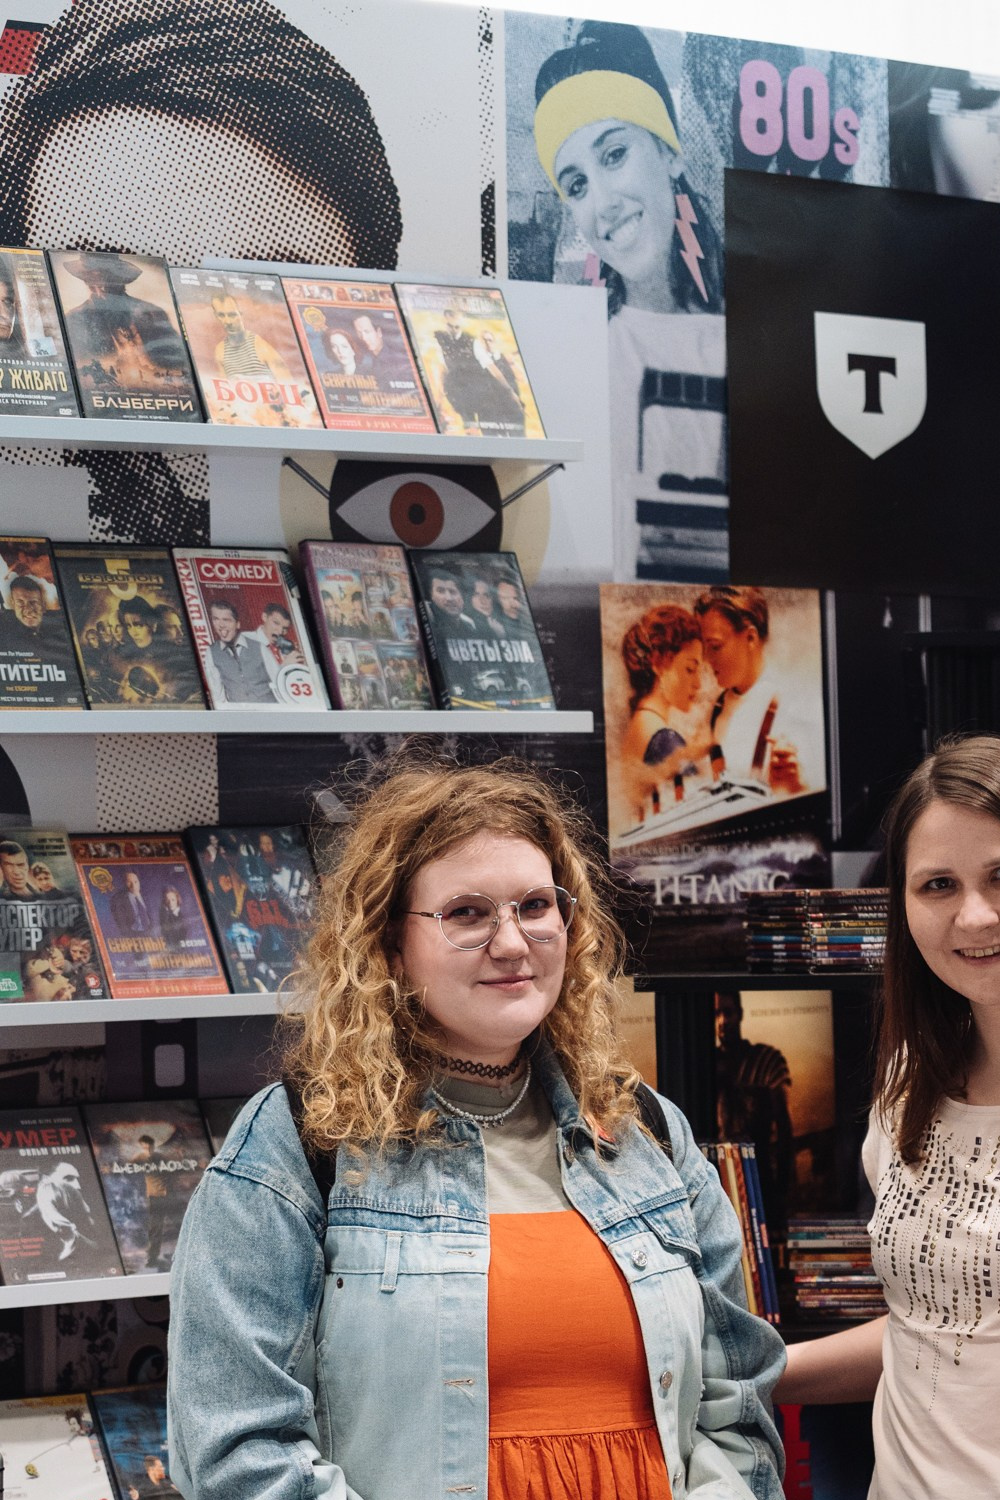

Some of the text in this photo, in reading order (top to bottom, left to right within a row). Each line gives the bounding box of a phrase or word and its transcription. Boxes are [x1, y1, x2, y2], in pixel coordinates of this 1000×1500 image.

[739, 59, 860, 166] 80s
[8, 367, 68, 392] ЖИВАГО
[846, 352, 897, 415] T
[91, 396, 194, 412] БЛУБЕРРИ
[211, 378, 306, 408] БОЕЦ
[201, 562, 274, 580] COMEDY
[175, 557, 206, 621] ШУТКИ
[447, 639, 536, 665] ЦВЕТЫ ЗЛА
[0, 664, 67, 682] ТИТЕЛЬ
[290, 683, 312, 697] 33
